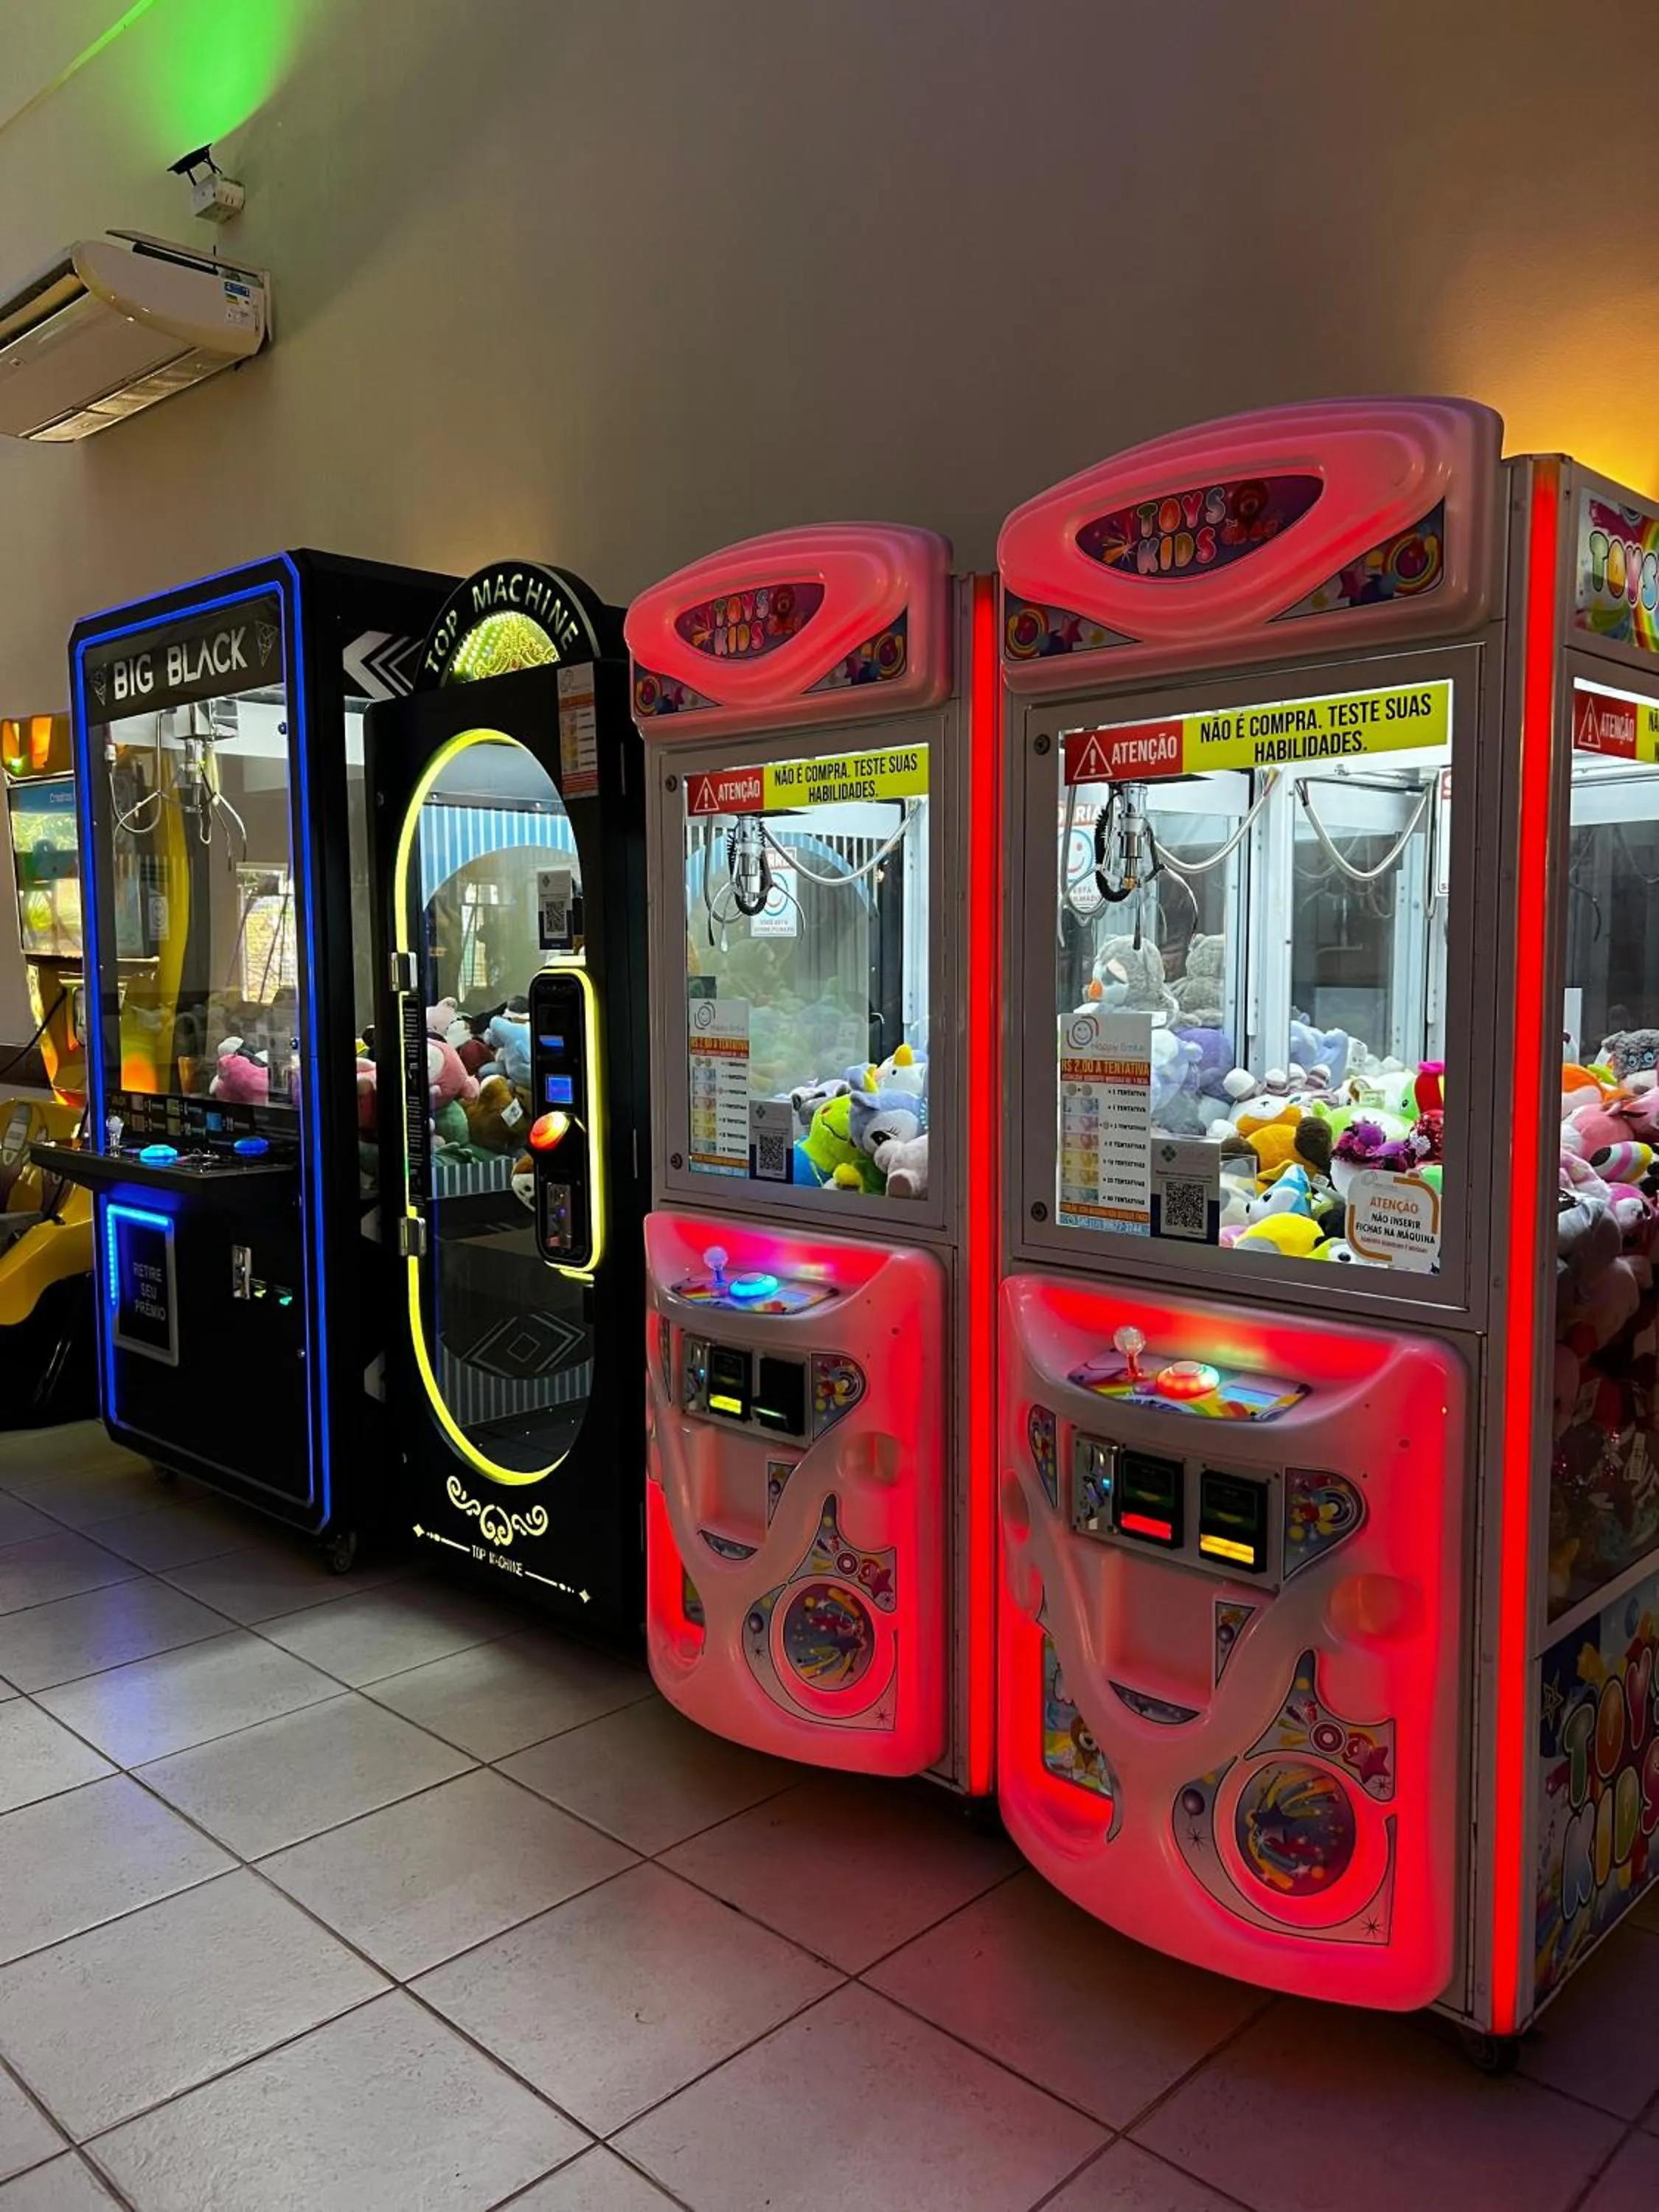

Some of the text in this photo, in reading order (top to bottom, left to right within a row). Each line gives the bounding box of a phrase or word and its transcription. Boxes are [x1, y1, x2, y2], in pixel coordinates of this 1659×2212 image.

[1136, 486, 1226, 538] TOYS
[1136, 526, 1217, 575] KIDS
[1589, 530, 1659, 611] TOYS
[424, 574, 579, 672] TOP MACHINE
[714, 589, 770, 627] TOYS
[713, 620, 765, 655] KIDS
[114, 626, 248, 700] BIG BLACK
[1200, 692, 1432, 743] NÃO É COMPRA. TESTE SUAS
[1600, 712, 1635, 745] ATENÇÃO
[1111, 735, 1178, 765] ATENÇÃO
[1254, 730, 1368, 763] HABILIDADES.
[775, 753, 918, 786] NÃO É COMPRA. TESTE SUAS
[717, 776, 760, 803] ATENÇÃO
[808, 782, 879, 803] HABILIDADES.
[1105, 1061, 1150, 1077] TENTATIVA
[1370, 1197, 1418, 1214] ATENÇÃO
[1371, 1212, 1421, 1229] NÃO INSERIR
[1356, 1222, 1436, 1244] FICHAS NA MÁQUINA
[472, 1545, 486, 1560] TOP
